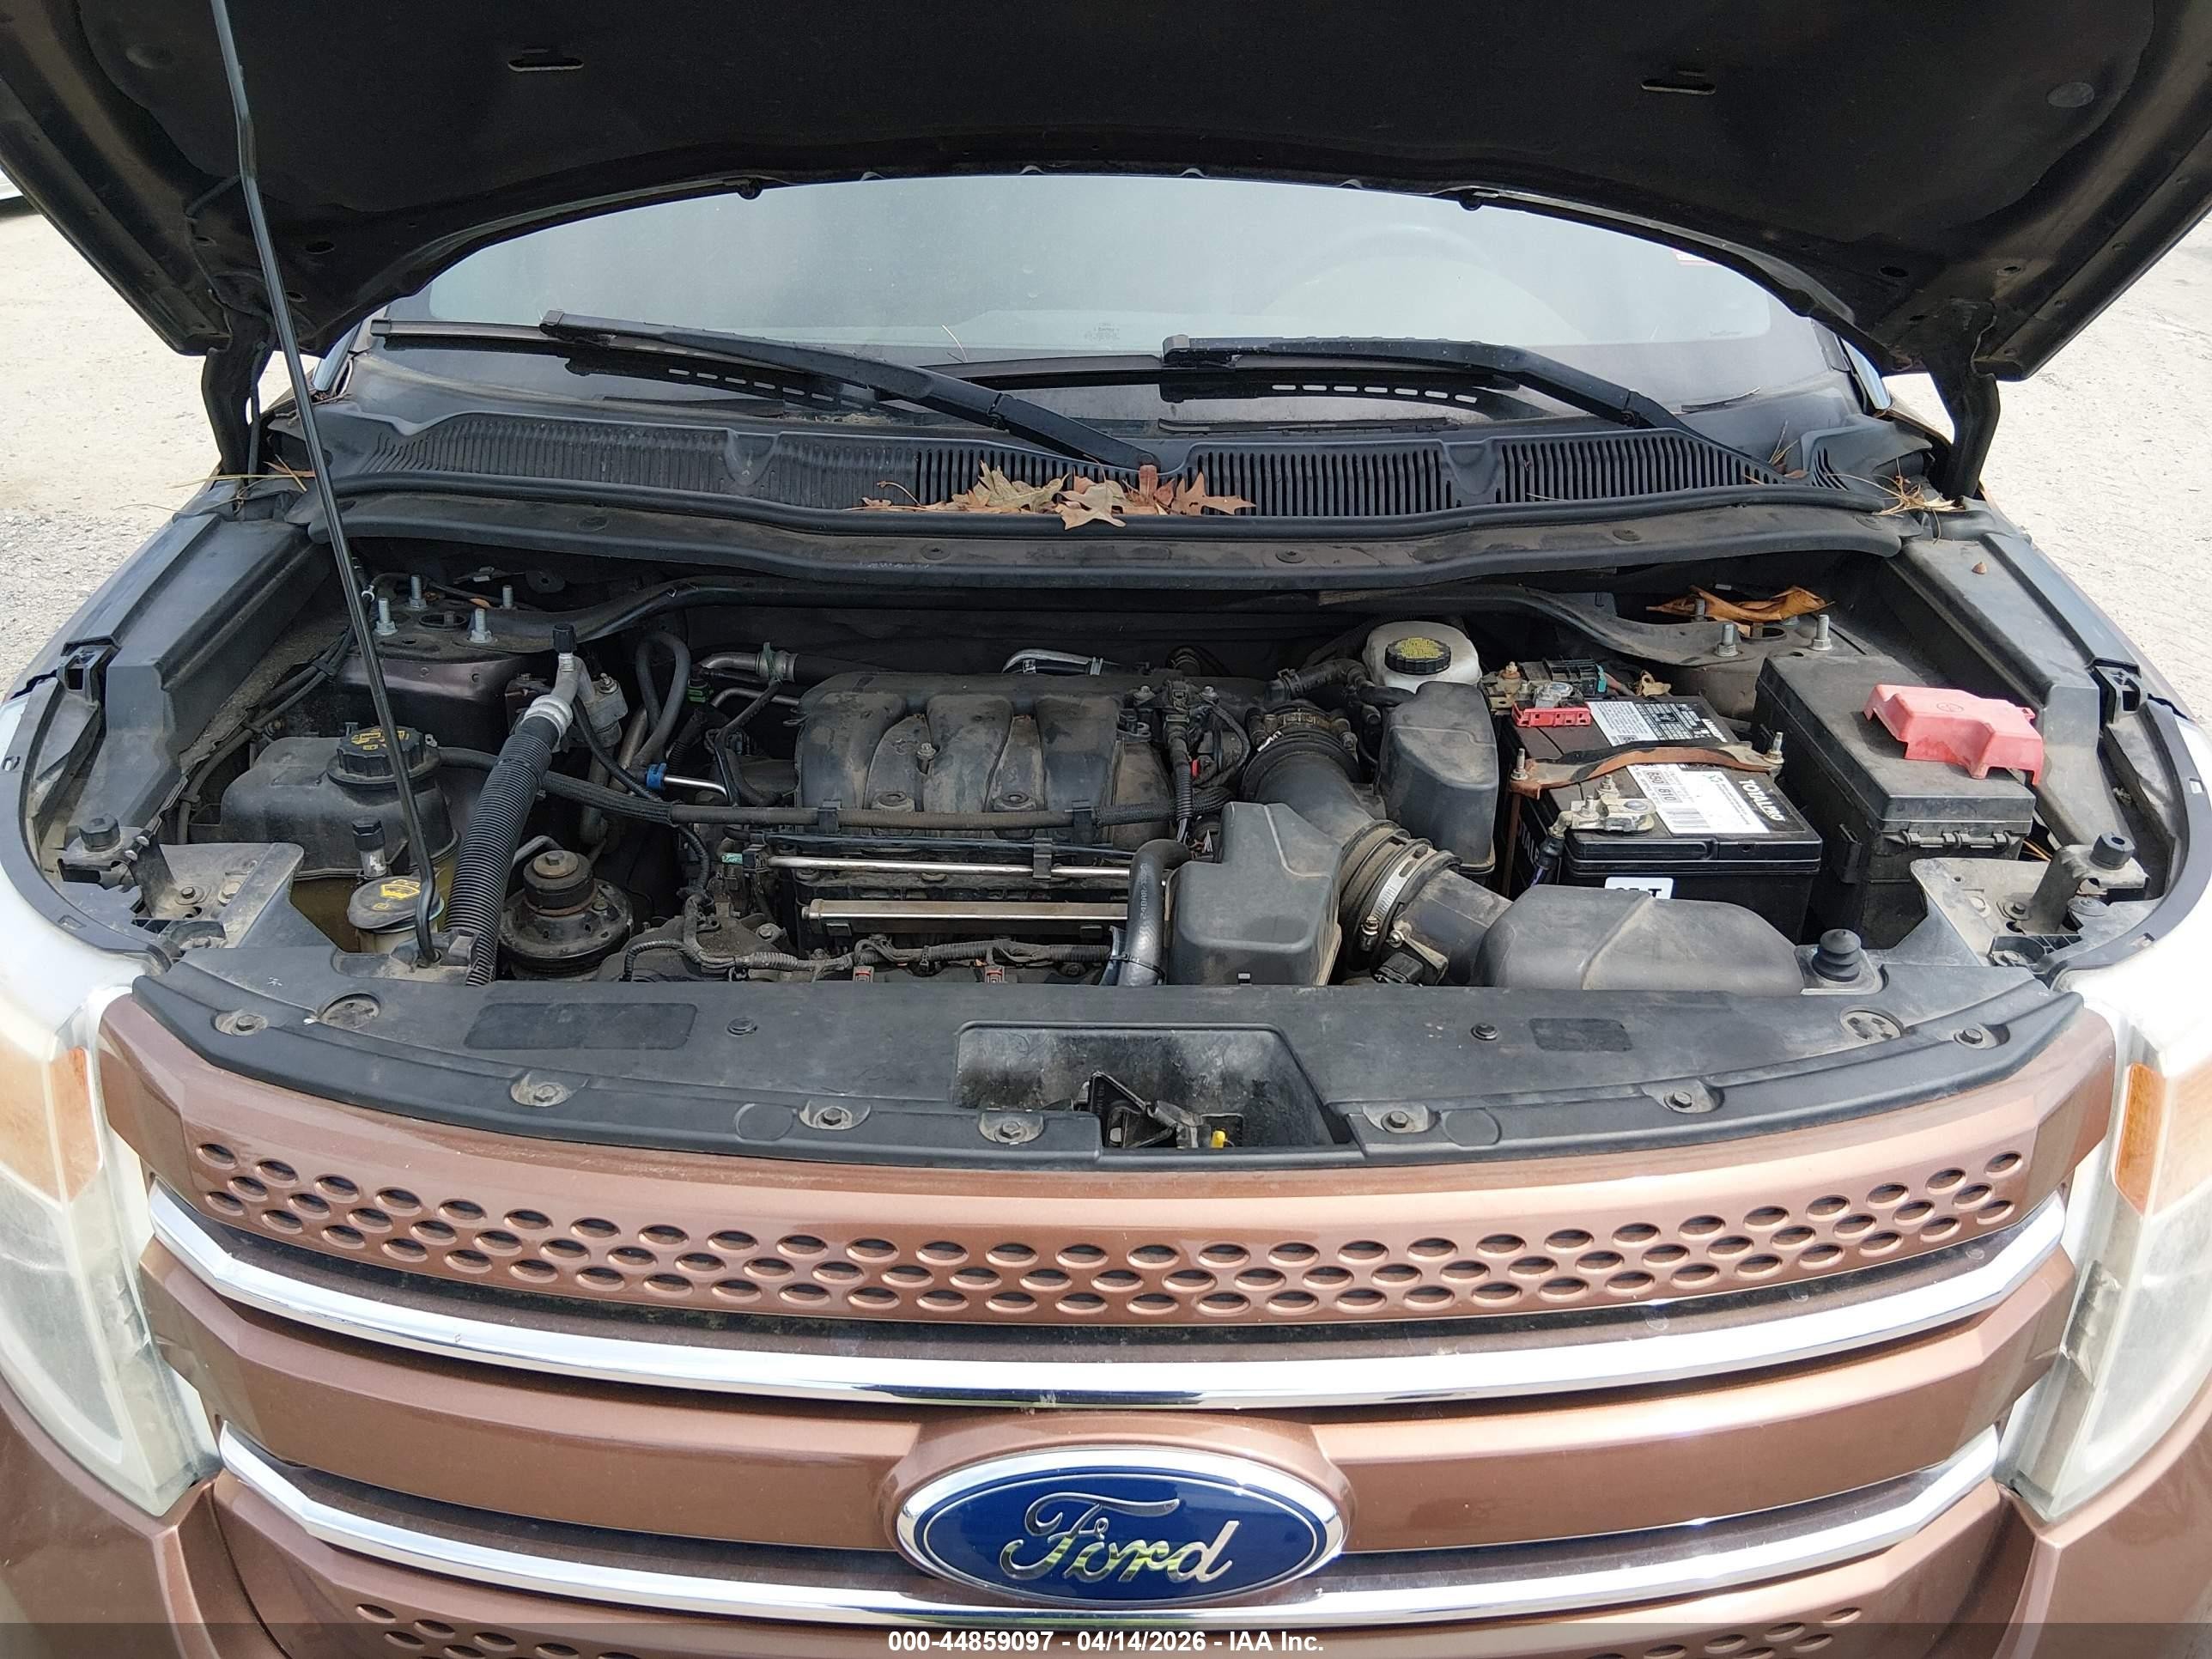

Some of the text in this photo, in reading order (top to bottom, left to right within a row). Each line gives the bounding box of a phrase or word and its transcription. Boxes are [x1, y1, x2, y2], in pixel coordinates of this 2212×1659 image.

[1647, 772, 1664, 784] 650
[1738, 779, 1784, 822] TOTALPRO
[1000, 1491, 1240, 1584] Ford
